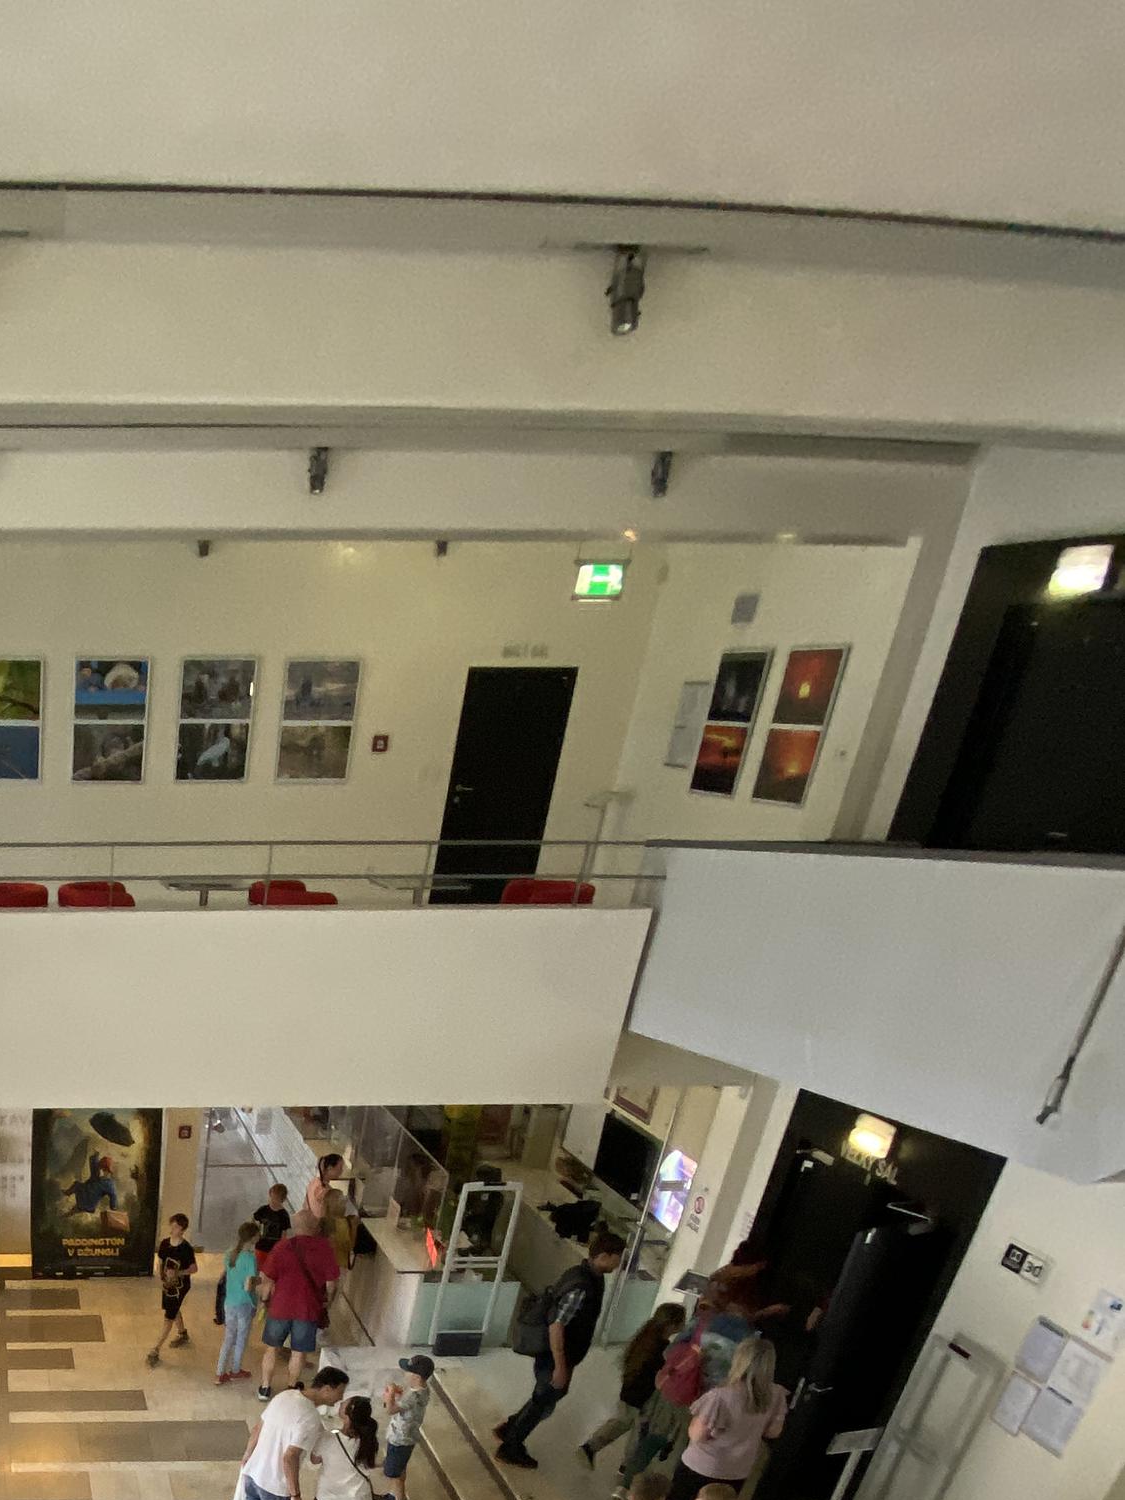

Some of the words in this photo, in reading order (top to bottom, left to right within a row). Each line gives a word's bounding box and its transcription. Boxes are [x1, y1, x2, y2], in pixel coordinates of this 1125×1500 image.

[62, 1238, 125, 1246] PADDINGTON
[67, 1248, 75, 1257] V
[77, 1246, 120, 1257] DŽUNGLI
